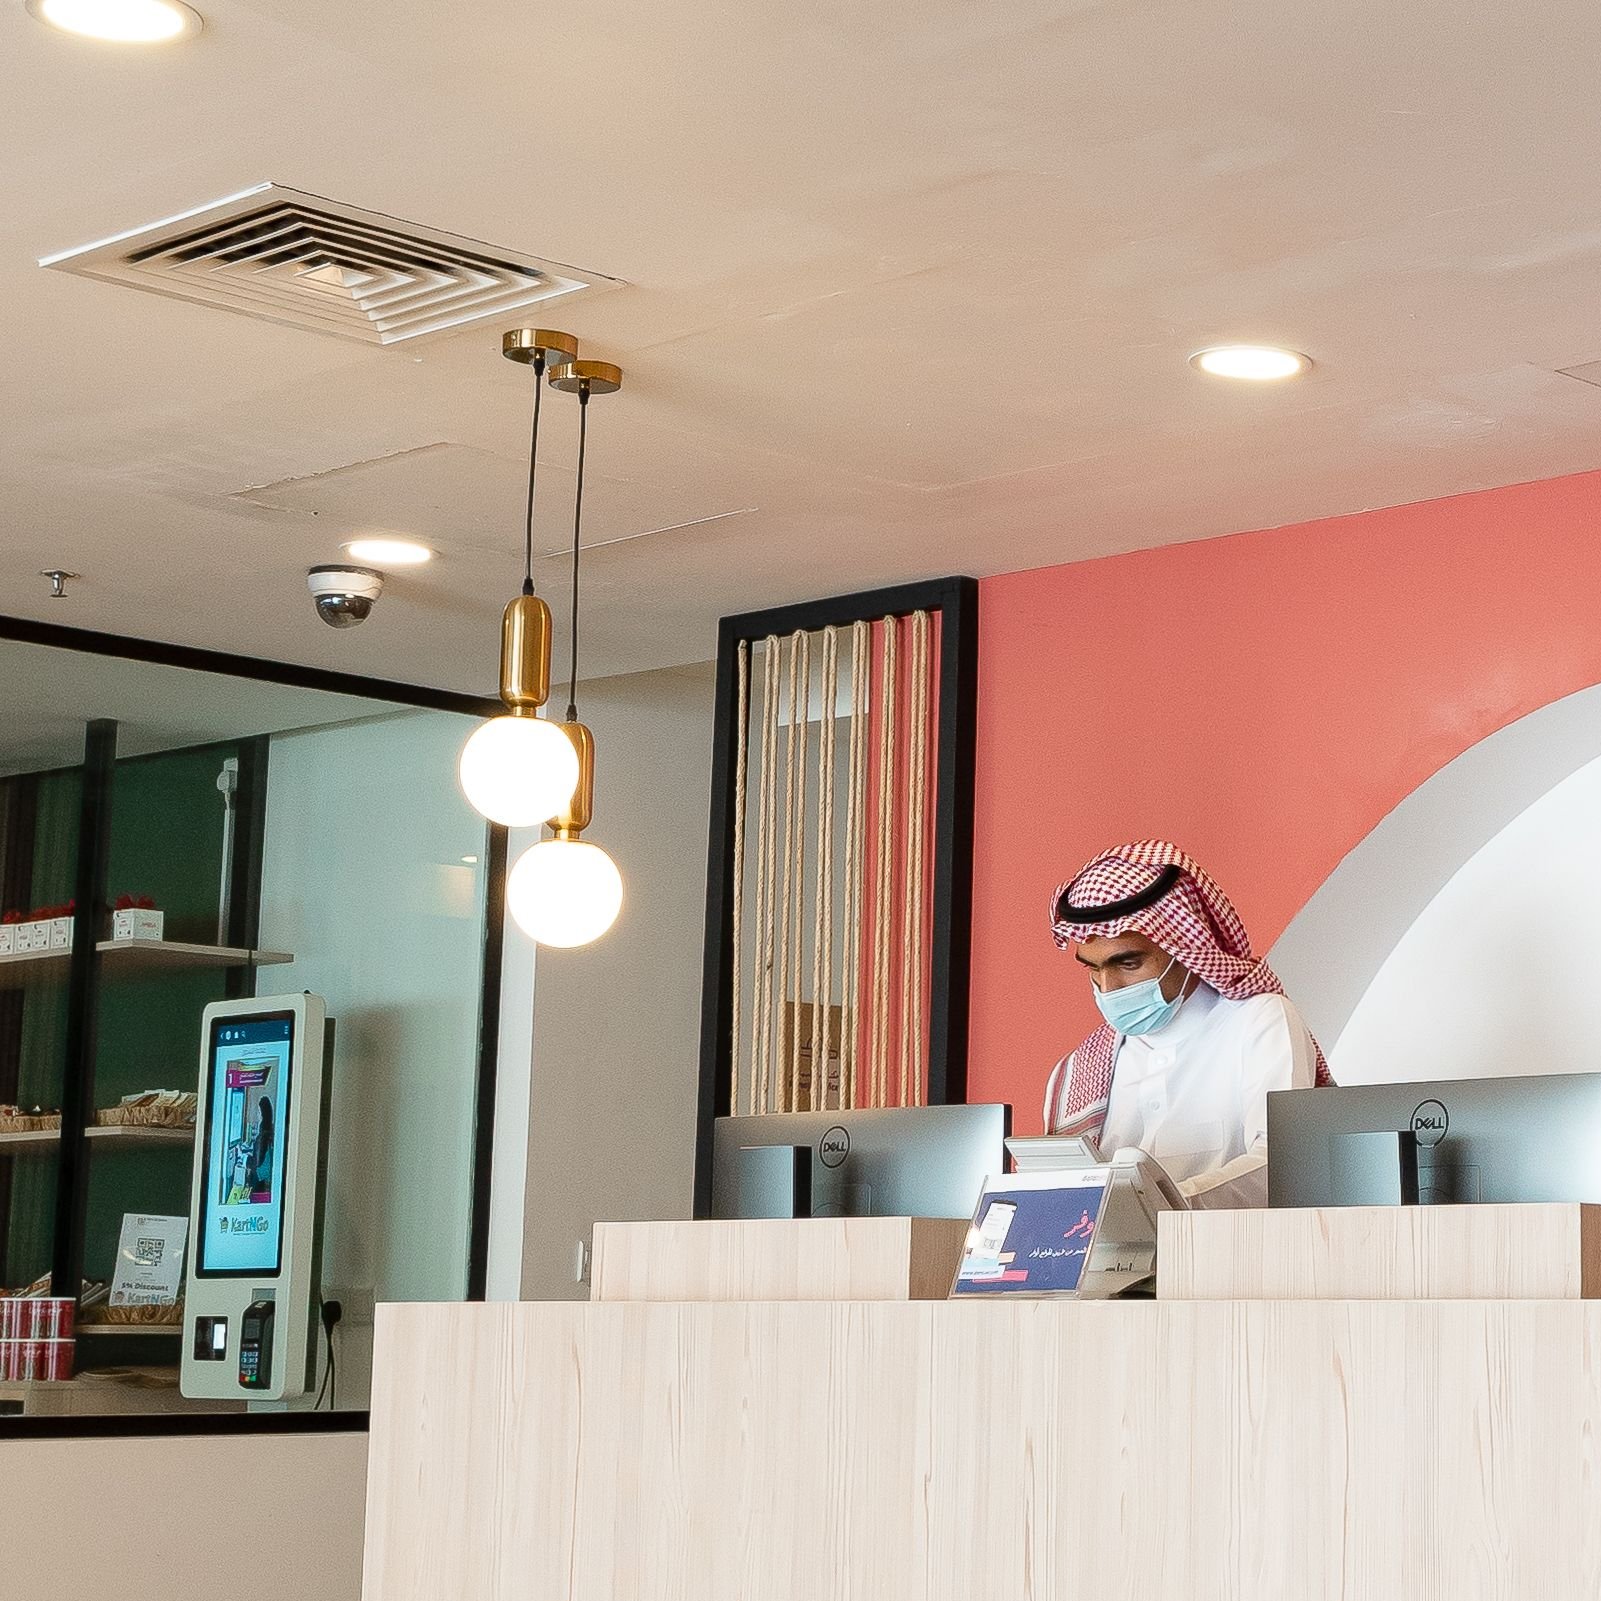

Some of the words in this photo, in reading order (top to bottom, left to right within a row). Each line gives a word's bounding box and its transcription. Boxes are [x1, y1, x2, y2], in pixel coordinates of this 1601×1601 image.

[1415, 1117, 1445, 1131] DELL
[823, 1141, 847, 1153] DELL
[134, 1282, 169, 1291] Discount
